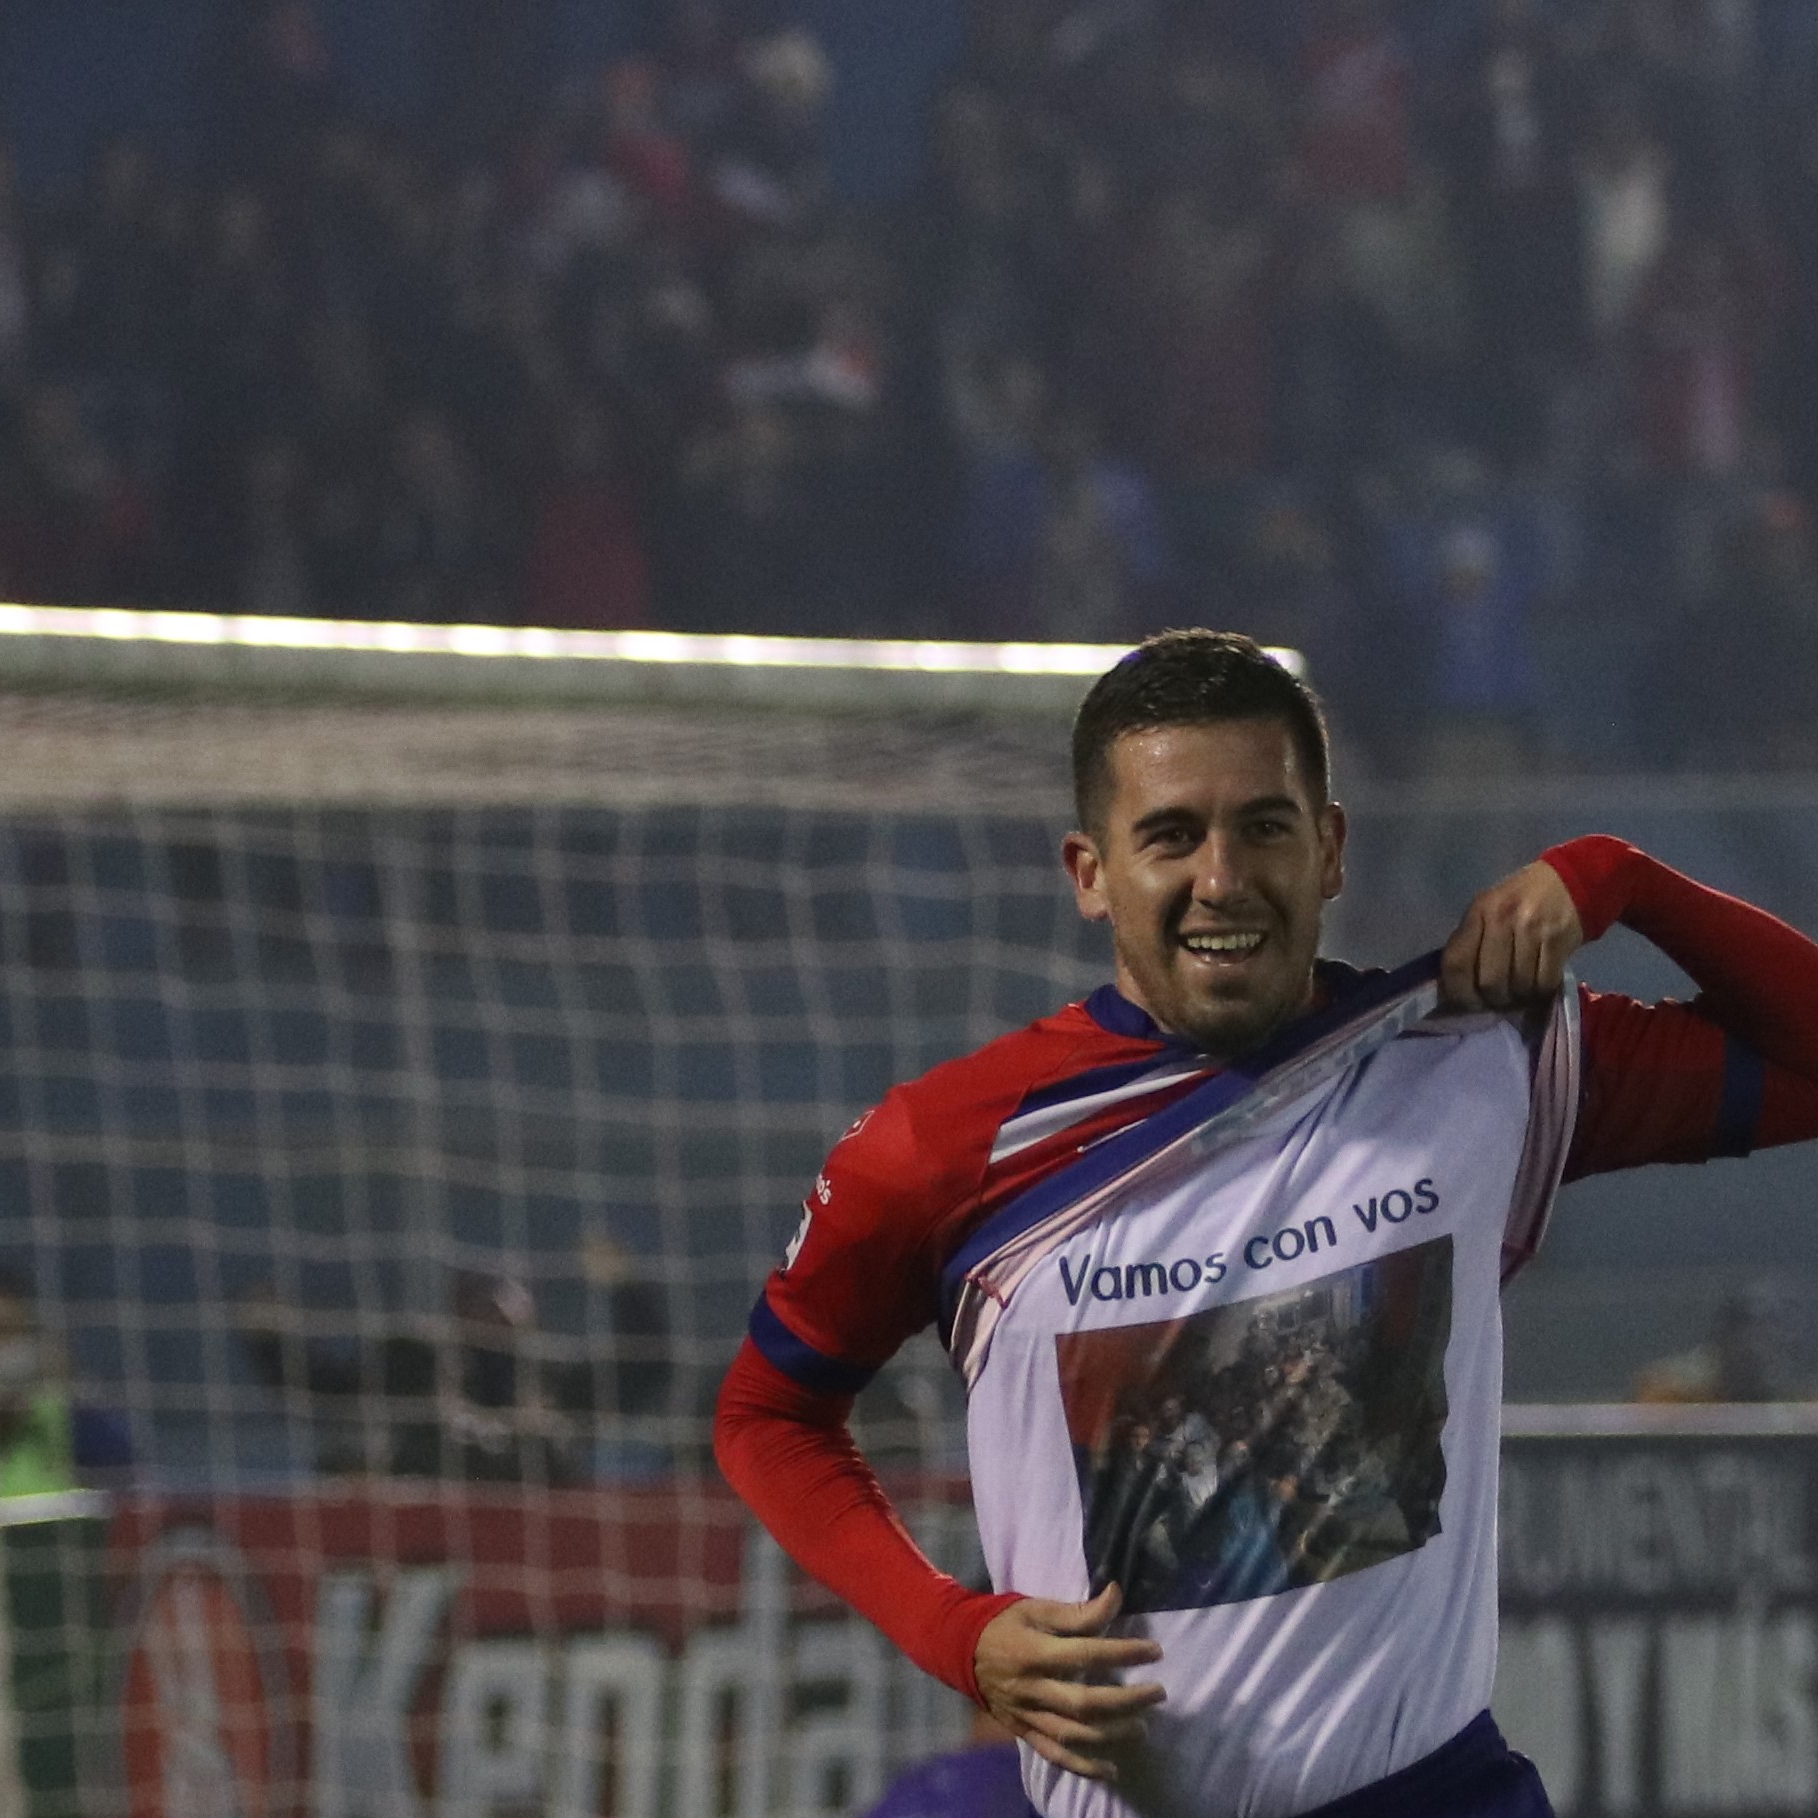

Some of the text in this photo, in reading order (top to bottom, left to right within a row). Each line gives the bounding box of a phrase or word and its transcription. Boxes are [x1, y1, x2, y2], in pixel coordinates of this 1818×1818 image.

[1059, 1177, 1440, 1307] Vamos con vos
